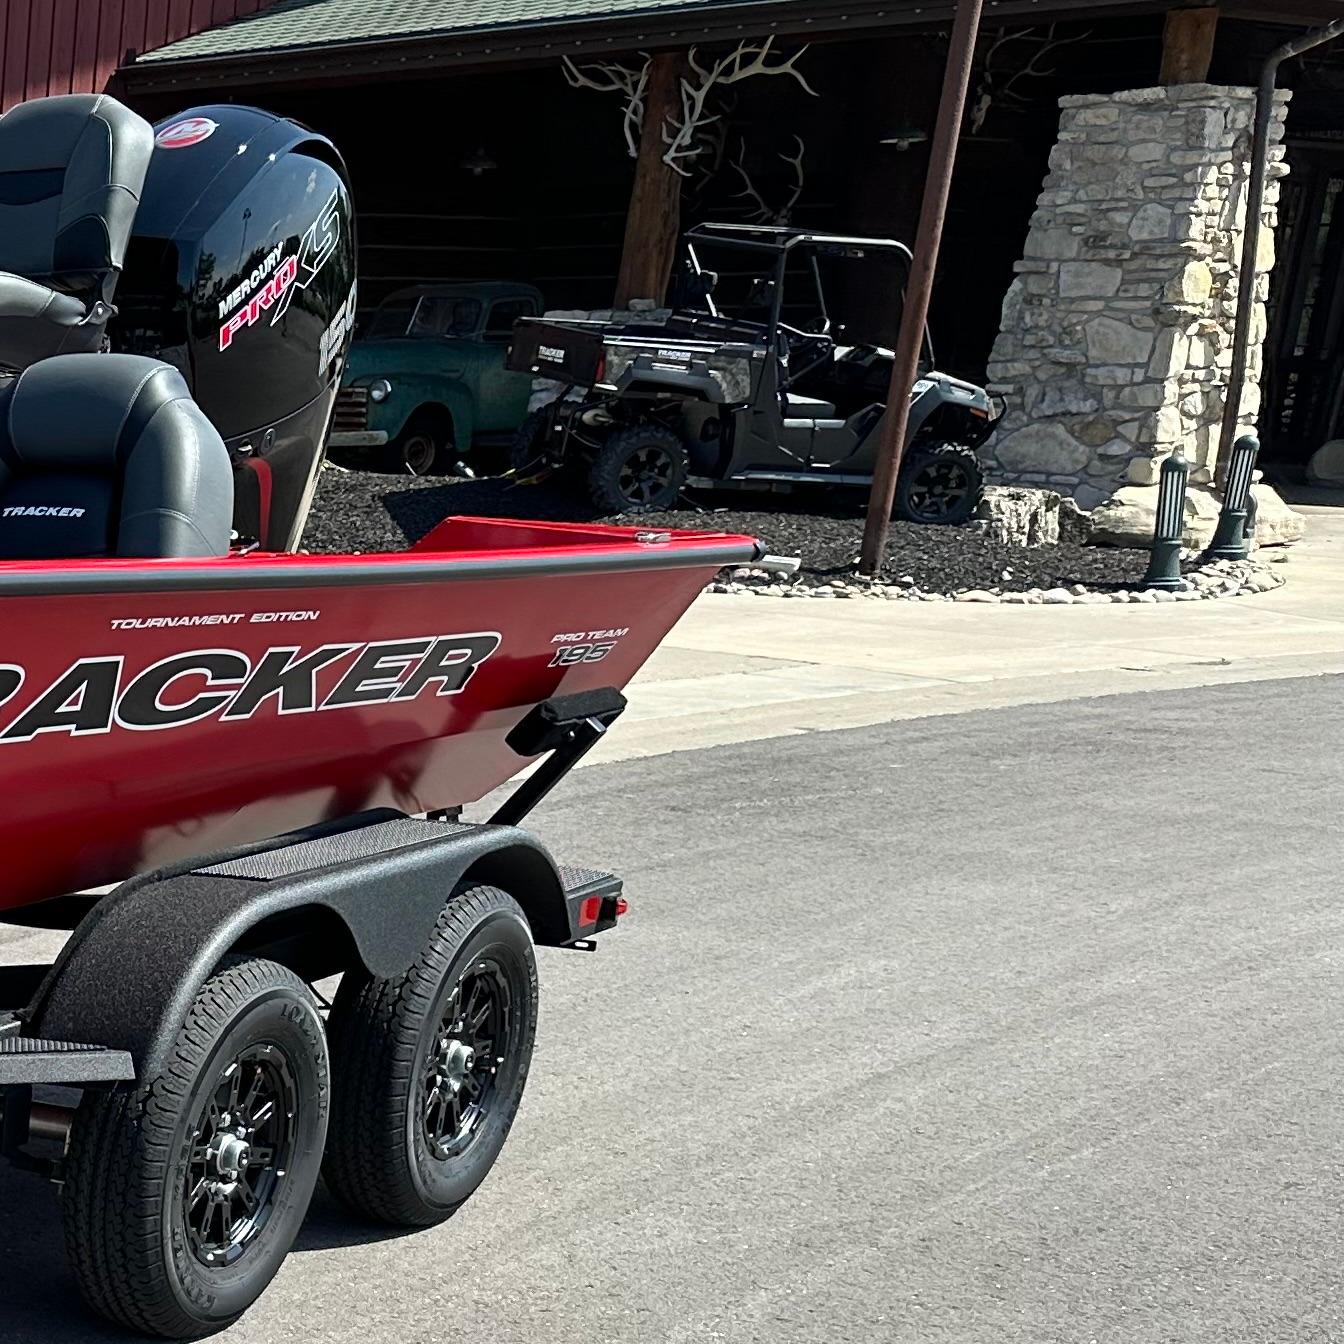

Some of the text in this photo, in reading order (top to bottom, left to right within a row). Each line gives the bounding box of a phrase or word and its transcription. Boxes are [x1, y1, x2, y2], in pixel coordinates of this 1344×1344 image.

[218, 241, 284, 319] MERCURY
[2, 506, 86, 518] TRACKER
[110, 610, 321, 630] TOURNAMENT EDITION
[550, 627, 630, 643] PRO TEAM
[547, 641, 619, 668] 195
